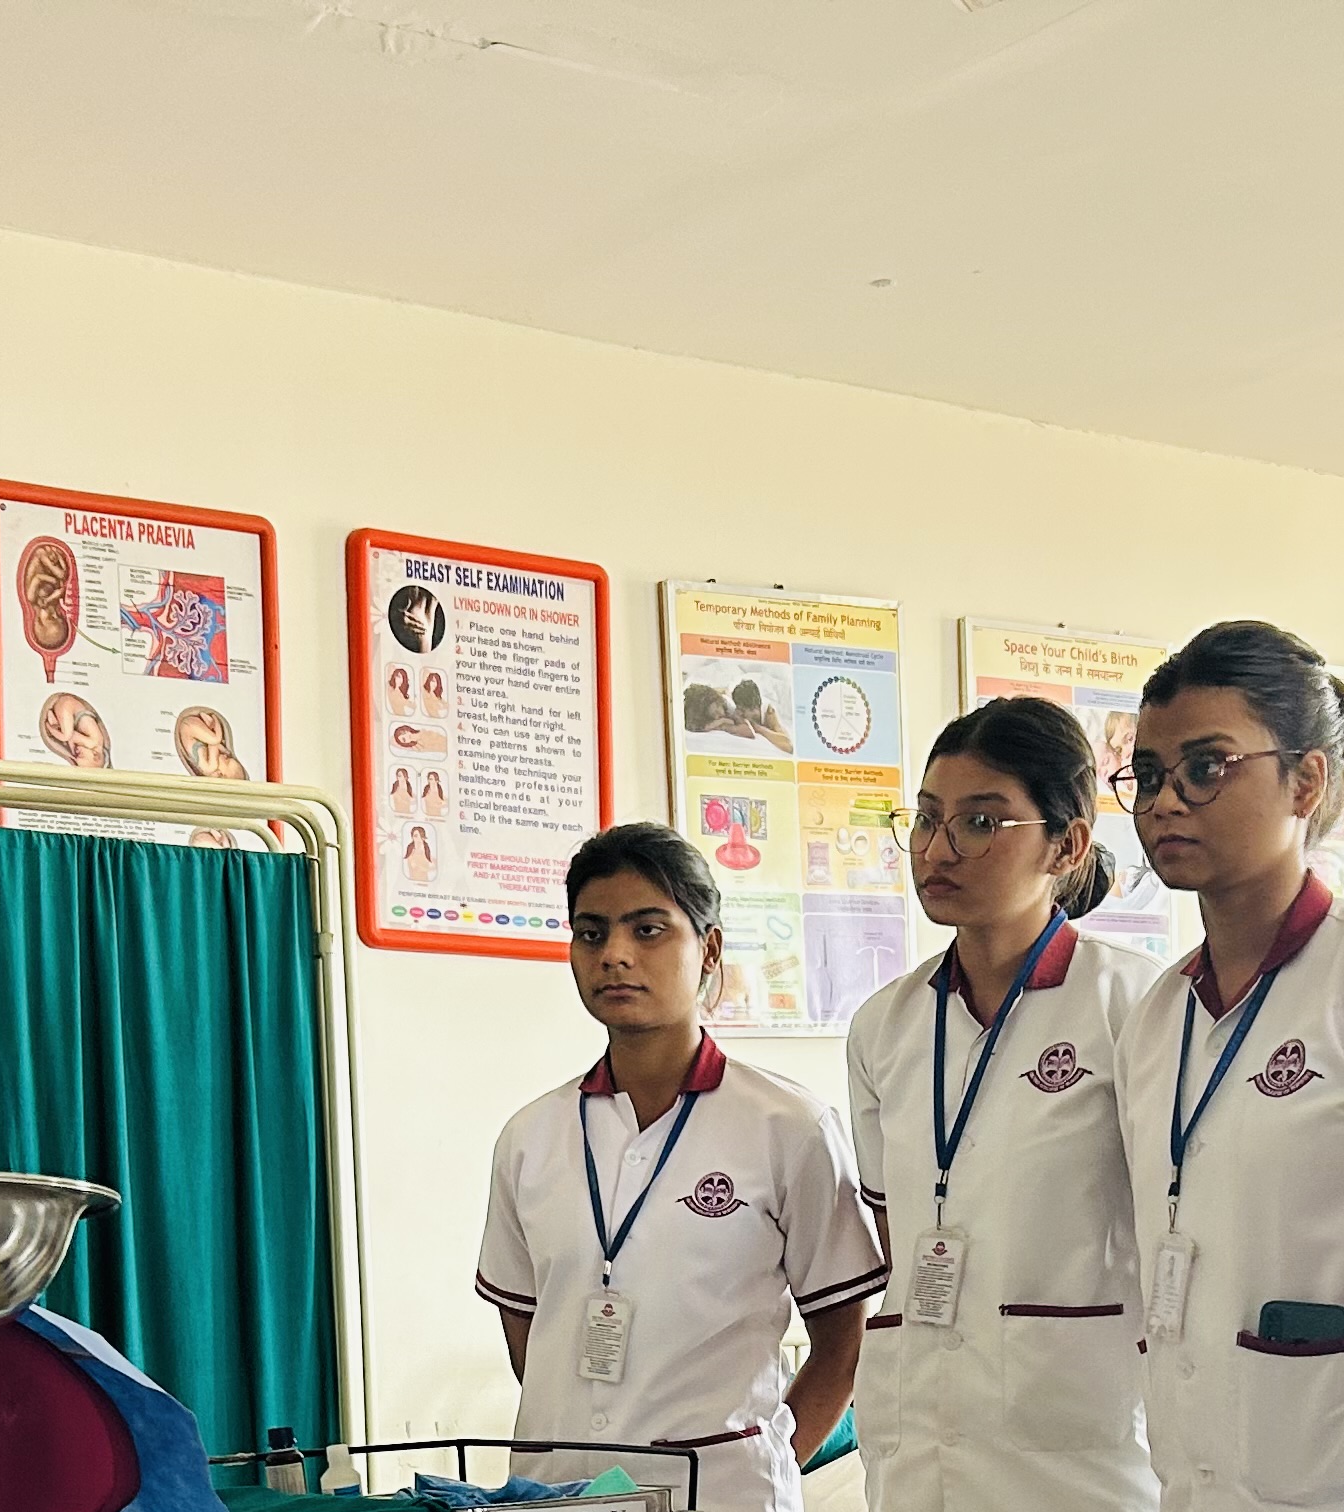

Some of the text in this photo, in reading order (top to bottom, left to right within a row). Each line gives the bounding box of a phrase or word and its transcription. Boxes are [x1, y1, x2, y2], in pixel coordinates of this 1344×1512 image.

[64, 512, 195, 550] PLACENTA PRAEVIA
[405, 558, 565, 601] BREAST SELF EXAMINATION
[454, 596, 580, 627] LYING DOWN OR IN SHOWER
[694, 600, 746, 619] Temporary
[750, 605, 790, 621] Methods
[793, 610, 804, 621] of
[806, 611, 838, 626] Family
[841, 615, 882, 631] Planning
[455, 635, 545, 654] your head as shown.
[470, 622, 494, 634] Place
[500, 628, 516, 637] one
[522, 629, 544, 641] hand
[549, 633, 579, 646] behind
[470, 647, 487, 658] Use
[493, 651, 507, 661] the
[513, 653, 539, 666] finger
[544, 659, 565, 668] pads
[571, 662, 580, 670] of
[1004, 639, 1038, 656] Space
[1040, 643, 1065, 659] Your
[1070, 647, 1107, 663] Child's
[1111, 652, 1138, 667] Birth
[456, 660, 580, 683] your three middle fingers to
[1042, 660, 1051, 674] के
[456, 672, 580, 696] move your hand over entire
[456, 684, 509, 699] breast area.
[471, 698, 489, 708] Use
[495, 702, 516, 713] right
[521, 704, 544, 716] hand
[549, 708, 561, 717] for
[567, 710, 581, 721] left
[490, 713, 504, 723] left
[506, 714, 527, 726] hand
[529, 718, 541, 728] for
[543, 721, 566, 732] right.
[472, 723, 489, 735] You
[493, 728, 509, 736] can
[514, 731, 530, 739] use
[535, 733, 550, 743] any
[554, 734, 563, 742] of
[567, 736, 581, 745] the
[457, 735, 582, 758] three patterns shown to
[458, 749, 554, 767] examine your breasts.
[472, 762, 490, 772] Use
[495, 764, 509, 774] the
[514, 767, 558, 780] technique
[562, 774, 581, 783] your
[459, 773, 583, 795] healthcare professional
[459, 787, 583, 807] recommends at your
[459, 799, 491, 810] clinical
[493, 802, 521, 813] breast
[459, 824, 482, 835] time.
[473, 812, 486, 822] Do
[490, 814, 495, 823] it
[498, 815, 512, 825] the
[515, 818, 539, 827] same
[542, 821, 560, 832] way
[562, 823, 583, 832] each
[500, 854, 530, 864] SHOULD
